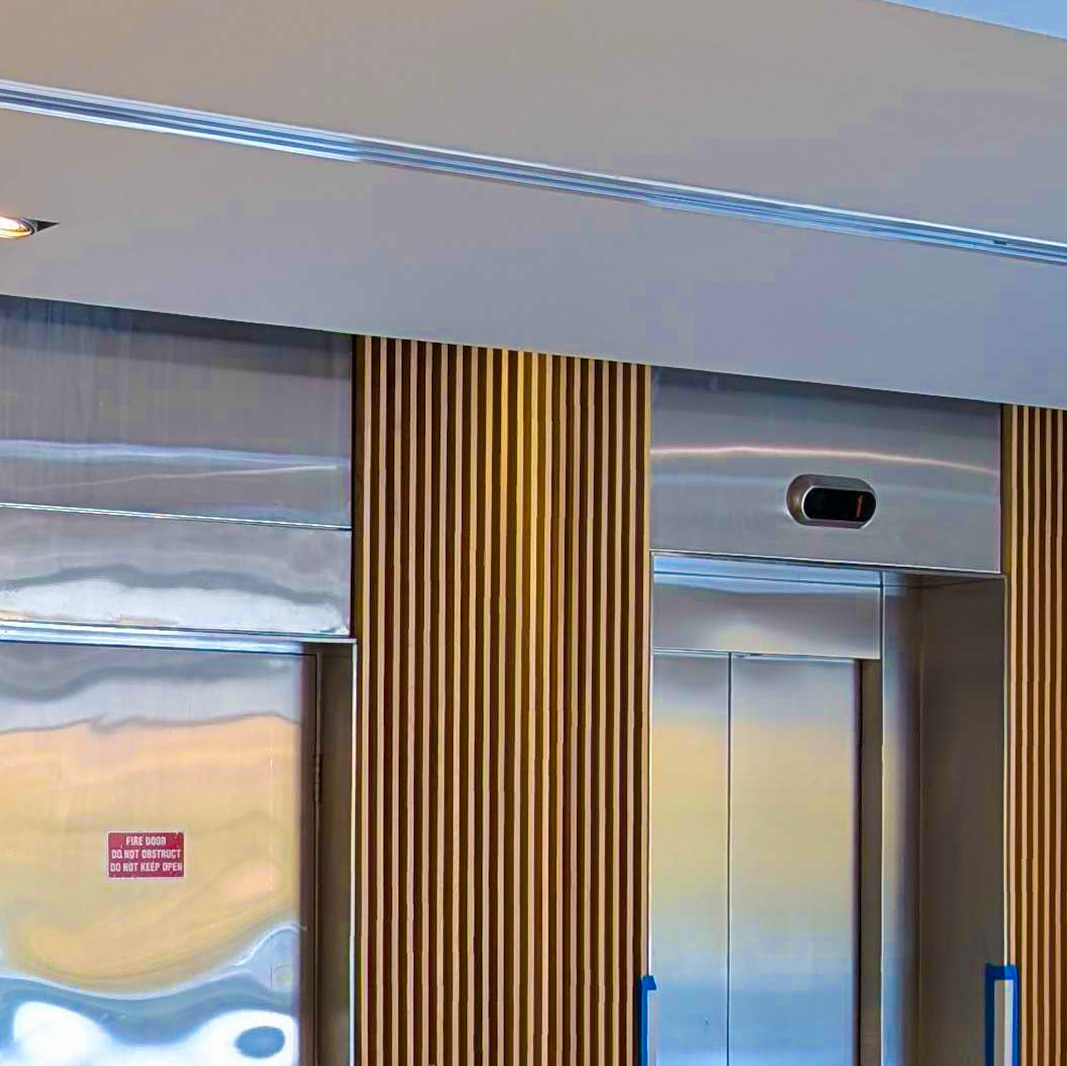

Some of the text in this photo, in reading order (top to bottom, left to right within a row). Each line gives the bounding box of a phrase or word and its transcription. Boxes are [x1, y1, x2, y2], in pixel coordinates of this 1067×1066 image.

[126, 836, 166, 846] FIRE DOOR
[111, 849, 181, 859] DO NOT OBSTRUCT
[110, 862, 183, 872] DO NOT KEEP OPEN
